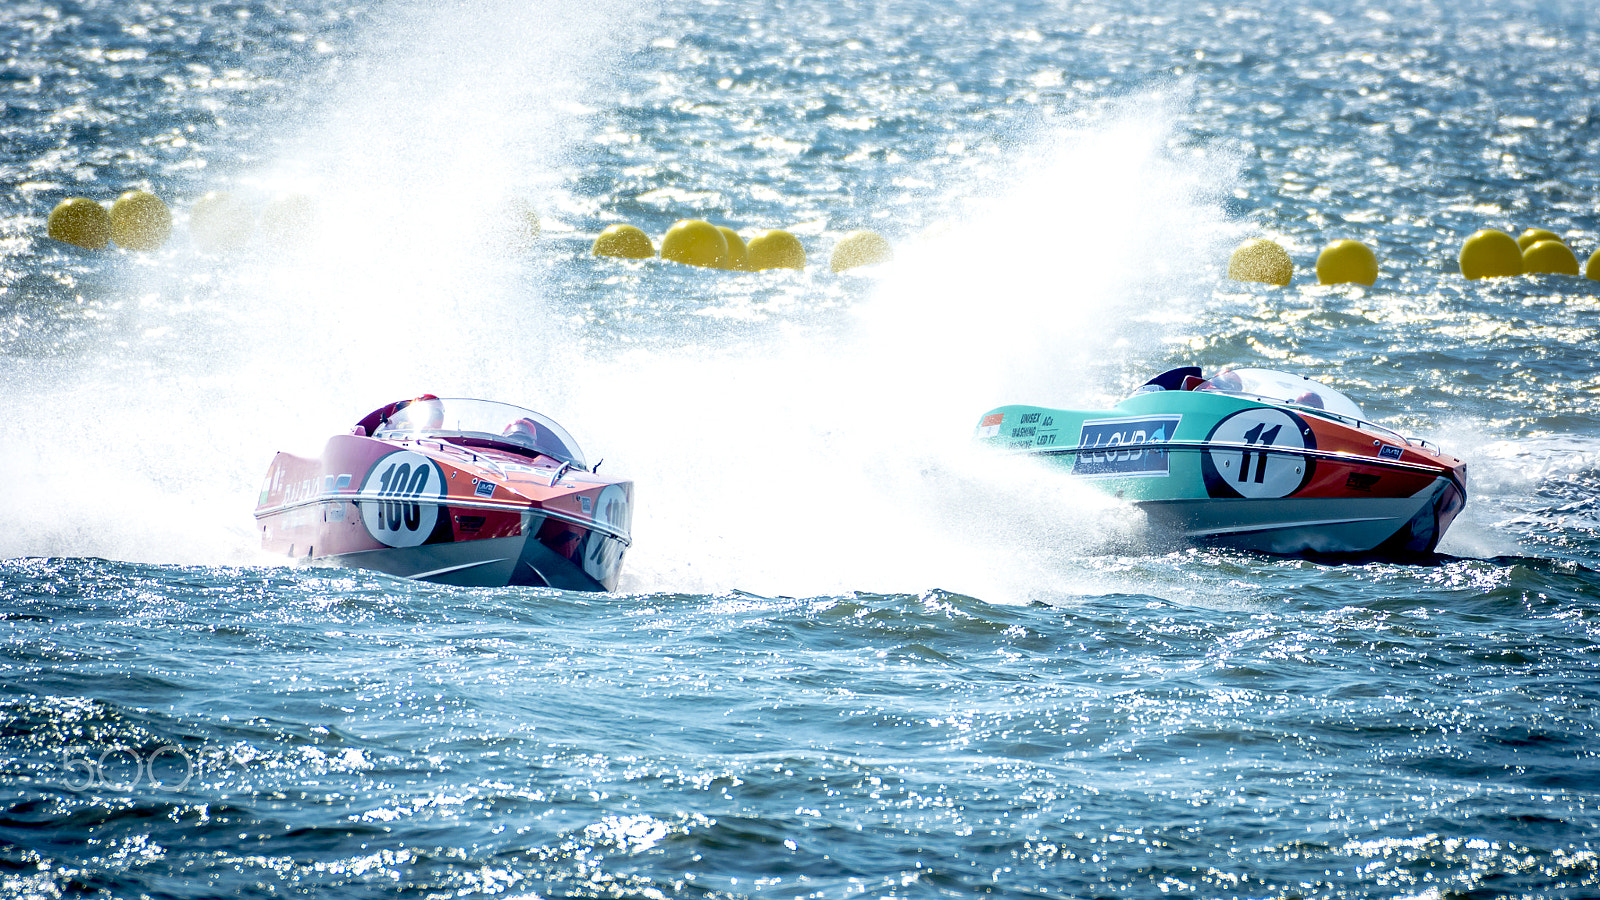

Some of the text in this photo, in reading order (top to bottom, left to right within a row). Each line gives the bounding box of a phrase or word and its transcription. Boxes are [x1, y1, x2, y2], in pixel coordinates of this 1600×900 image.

[1020, 413, 1041, 424] UNISEX
[1012, 427, 1036, 437] WASHING
[1037, 434, 1056, 445] LED TV
[1238, 423, 1282, 484] 11
[377, 463, 430, 531] 100
